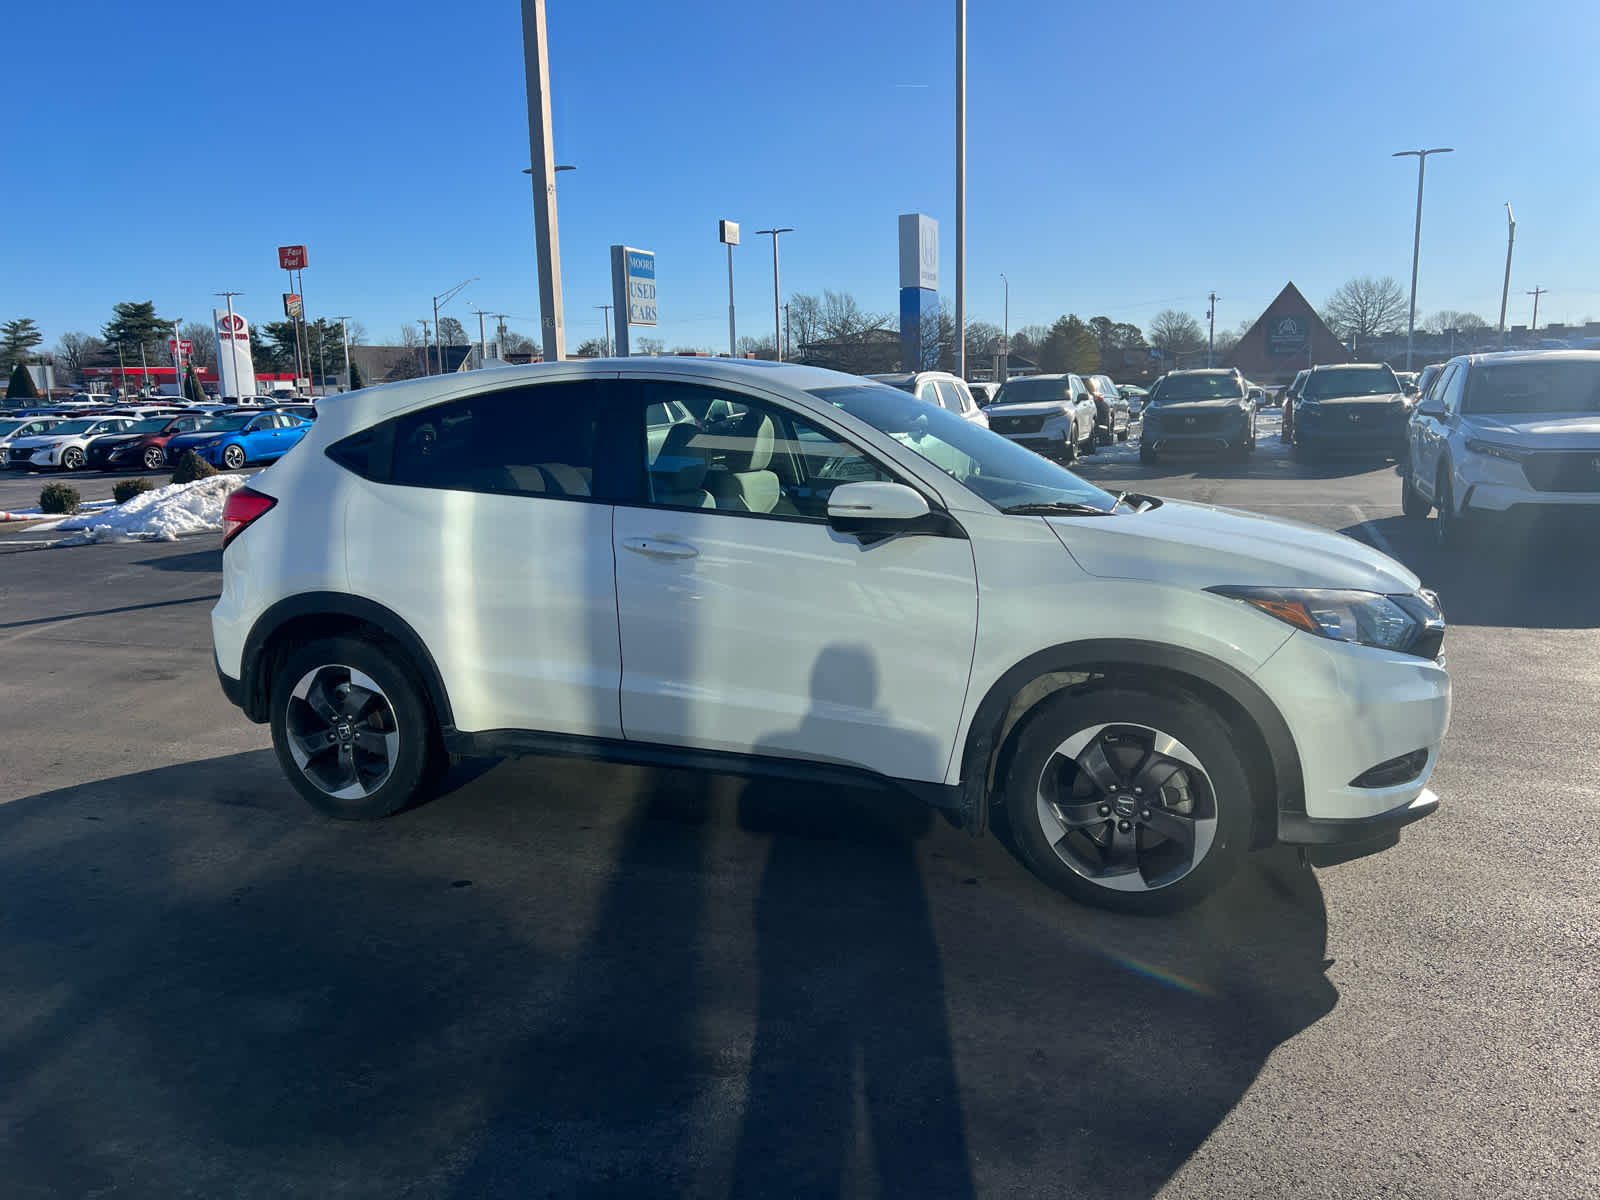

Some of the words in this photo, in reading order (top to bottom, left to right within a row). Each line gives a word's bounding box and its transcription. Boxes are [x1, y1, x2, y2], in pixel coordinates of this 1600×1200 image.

[630, 256, 655, 271] MOORE
[630, 281, 656, 299] USED
[631, 304, 656, 321] CARS
